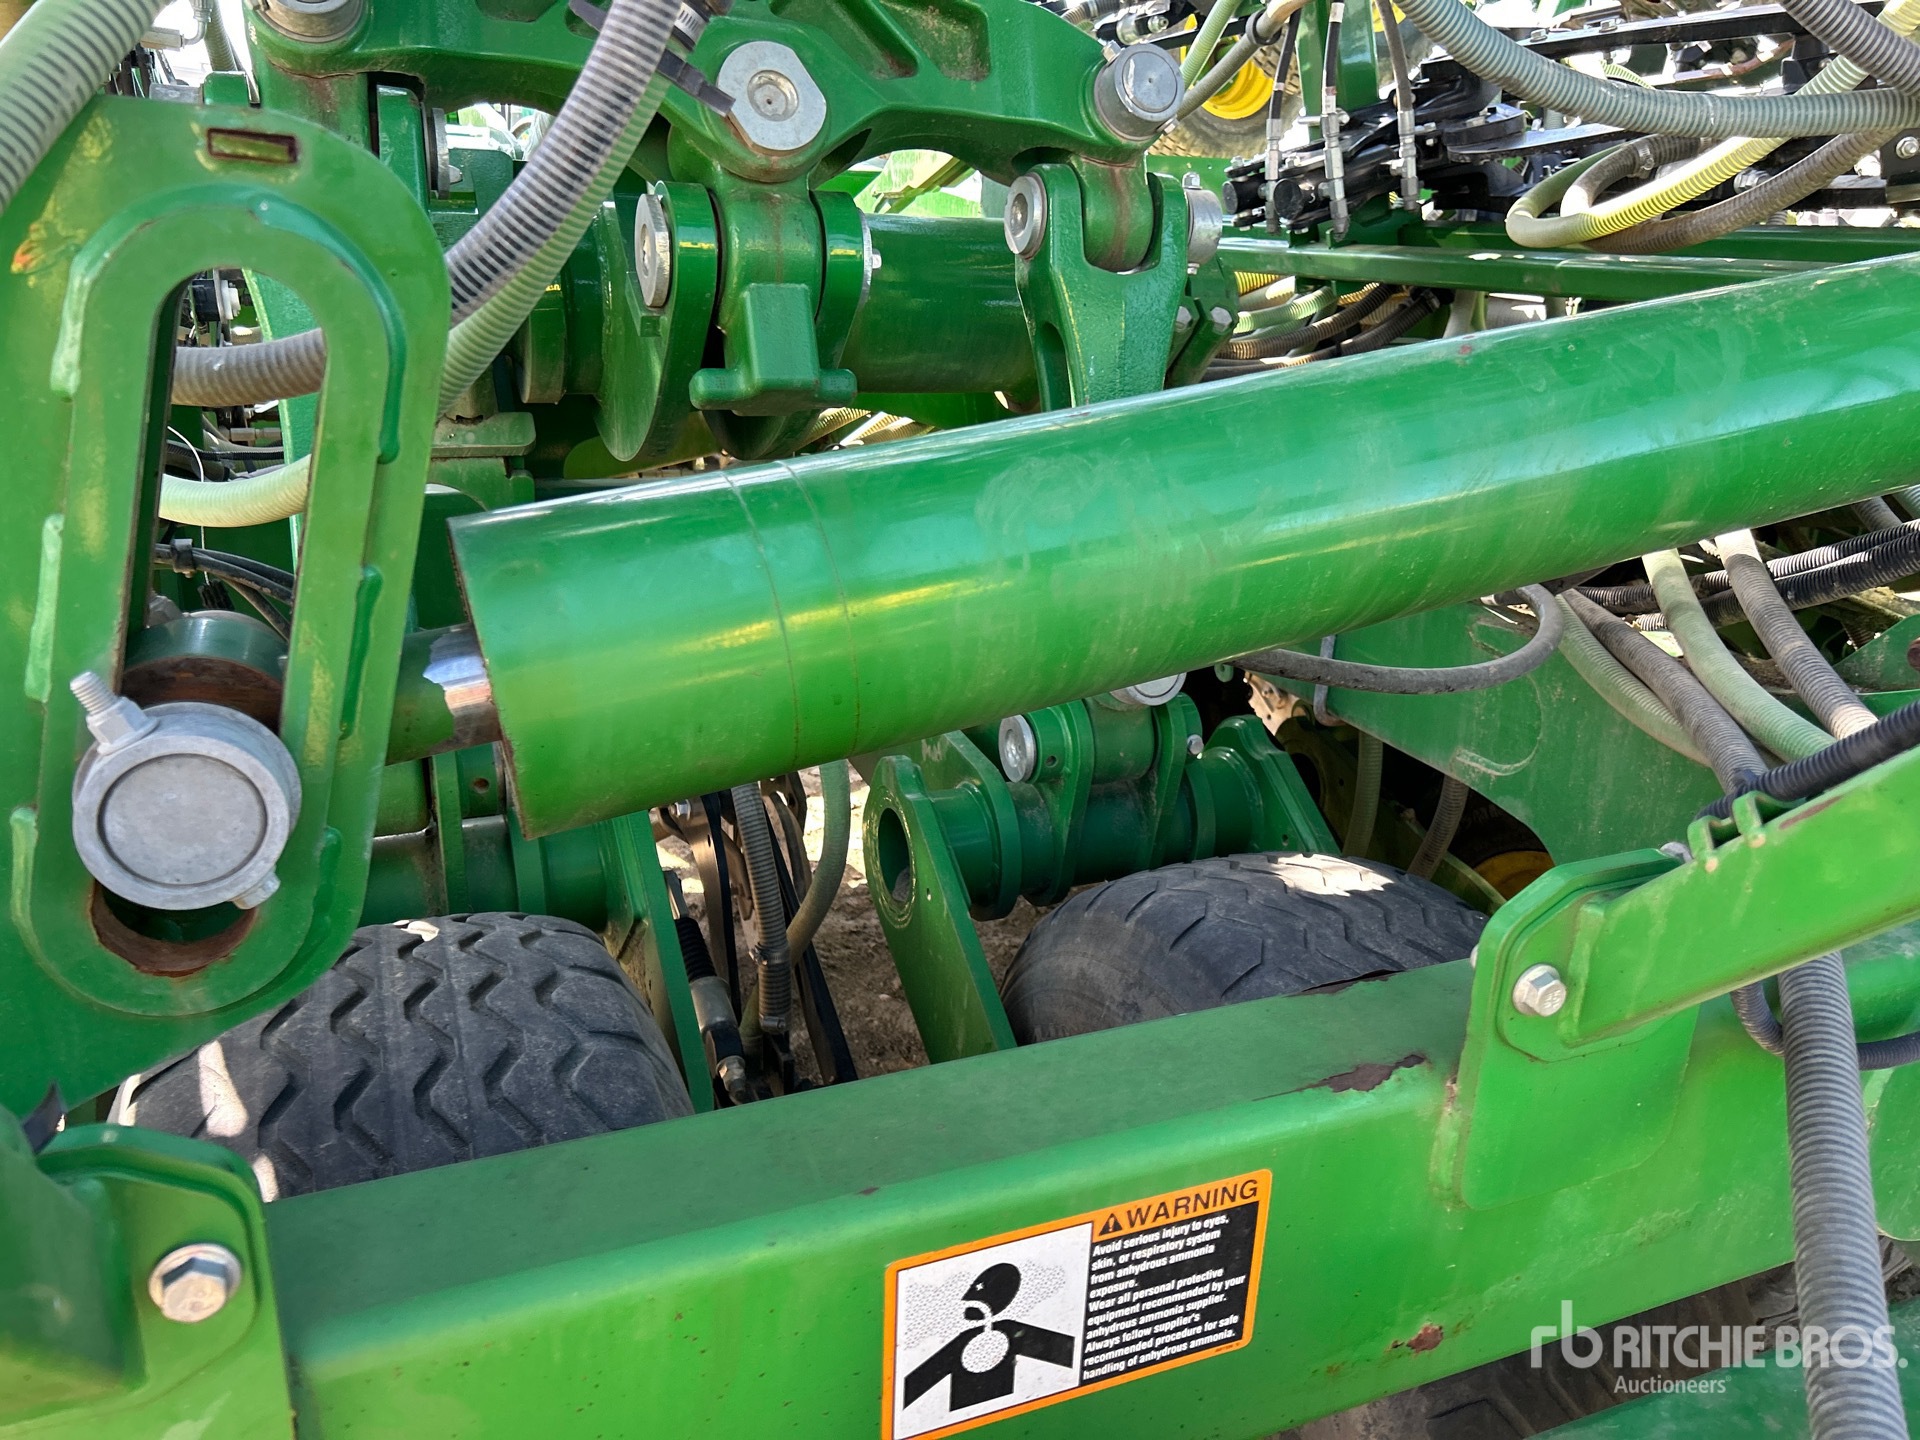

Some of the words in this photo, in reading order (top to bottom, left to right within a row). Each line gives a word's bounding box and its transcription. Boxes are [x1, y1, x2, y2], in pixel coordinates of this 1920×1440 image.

[1127, 1179, 1258, 1228] WARNING
[1092, 1240, 1121, 1256] Avoid
[1124, 1232, 1160, 1249] serious
[1162, 1225, 1189, 1241] injury
[1192, 1221, 1201, 1232] to
[1092, 1257, 1115, 1271] skin,
[1119, 1253, 1130, 1263] or
[1132, 1239, 1184, 1260] respiratory
[1187, 1230, 1221, 1246] system
[1091, 1271, 1113, 1285] from
[1117, 1257, 1167, 1281] anhydrous
[1169, 1244, 1215, 1264] ammonia
[1087, 1305, 1140, 1327] equipment
[1142, 1285, 1209, 1310] recommended
[1212, 1280, 1222, 1294] by
[1225, 1276, 1246, 1290] your
[1089, 1279, 1138, 1299] exposure.
[1089, 1297, 1115, 1312] Wear
[1119, 1292, 1130, 1304] all
[1133, 1280, 1174, 1302] personal
[1177, 1268, 1223, 1289] protective
[1085, 1336, 1120, 1354] Always
[1122, 1328, 1151, 1343] follow
[1154, 1313, 1200, 1335] supplier's
[1086, 1317, 1137, 1340] anhydrous
[1139, 1305, 1183, 1323] ammonia
[1186, 1294, 1226, 1313] supplier.
[1083, 1360, 1124, 1380] handling
[1127, 1354, 1137, 1366] of
[1139, 1342, 1187, 1364] anhydrous
[1189, 1329, 1235, 1351] ammonia.
[1084, 1338, 1153, 1366] recommended
[1155, 1324, 1201, 1348] procedure
[1204, 1320, 1216, 1332] for
[1219, 1314, 1239, 1327] safe
